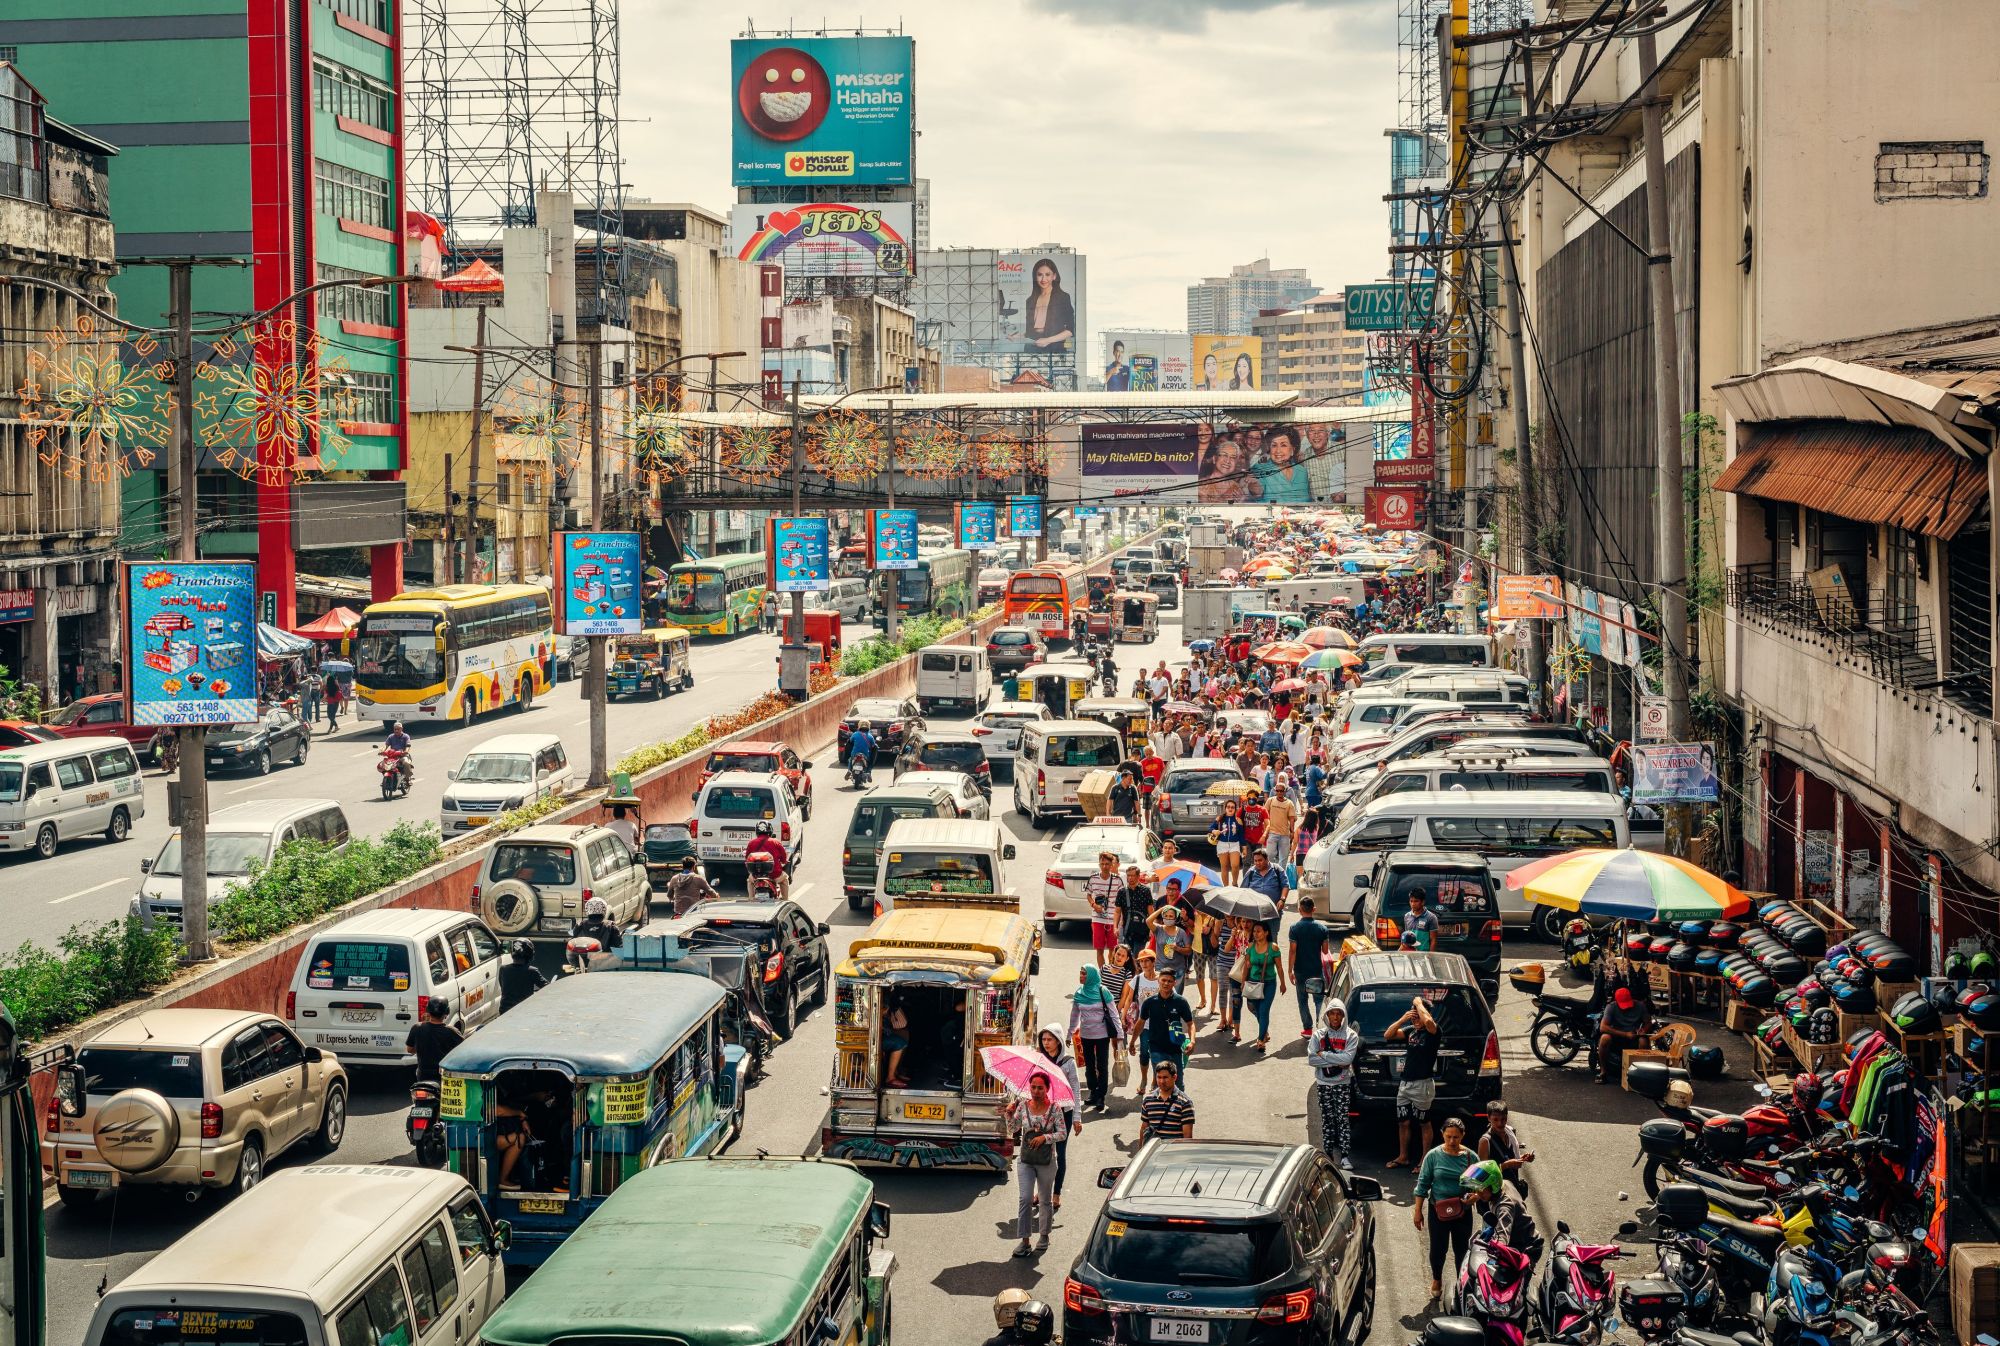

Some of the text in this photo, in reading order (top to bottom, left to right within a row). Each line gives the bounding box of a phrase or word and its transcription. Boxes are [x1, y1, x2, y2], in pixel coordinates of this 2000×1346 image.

[836, 73, 904, 86] mister
[837, 88, 903, 104] Hahaha
[806, 156, 849, 164] mister
[806, 164, 849, 172] Donut
[756, 210, 881, 237] I JED'S
[882, 250, 904, 263] 24
[1347, 288, 1434, 314] CITYSTATE
[1349, 316, 1374, 325] HOTEL
[1136, 371, 1152, 380] SUN
[1086, 453, 1194, 464] May RiteMED ba nito?
[1376, 464, 1433, 477] PAWNSHOP
[176, 576, 240, 586] Franchise
[13, 591, 33, 607] BICYCLE
[177, 703, 218, 712] 563 1408
[164, 713, 230, 722] 0927 011 8000
[1652, 758, 1696, 768] NAZARENO
[512, 904, 521, 918] ISUZU
[316, 1034, 368, 1045] UV Express Service
[909, 1106, 942, 1116] TWZ 122
[181, 1312, 218, 1326] BENTE
[219, 1320, 227, 1328] ON
[1176, 1324, 1202, 1336] 2063
